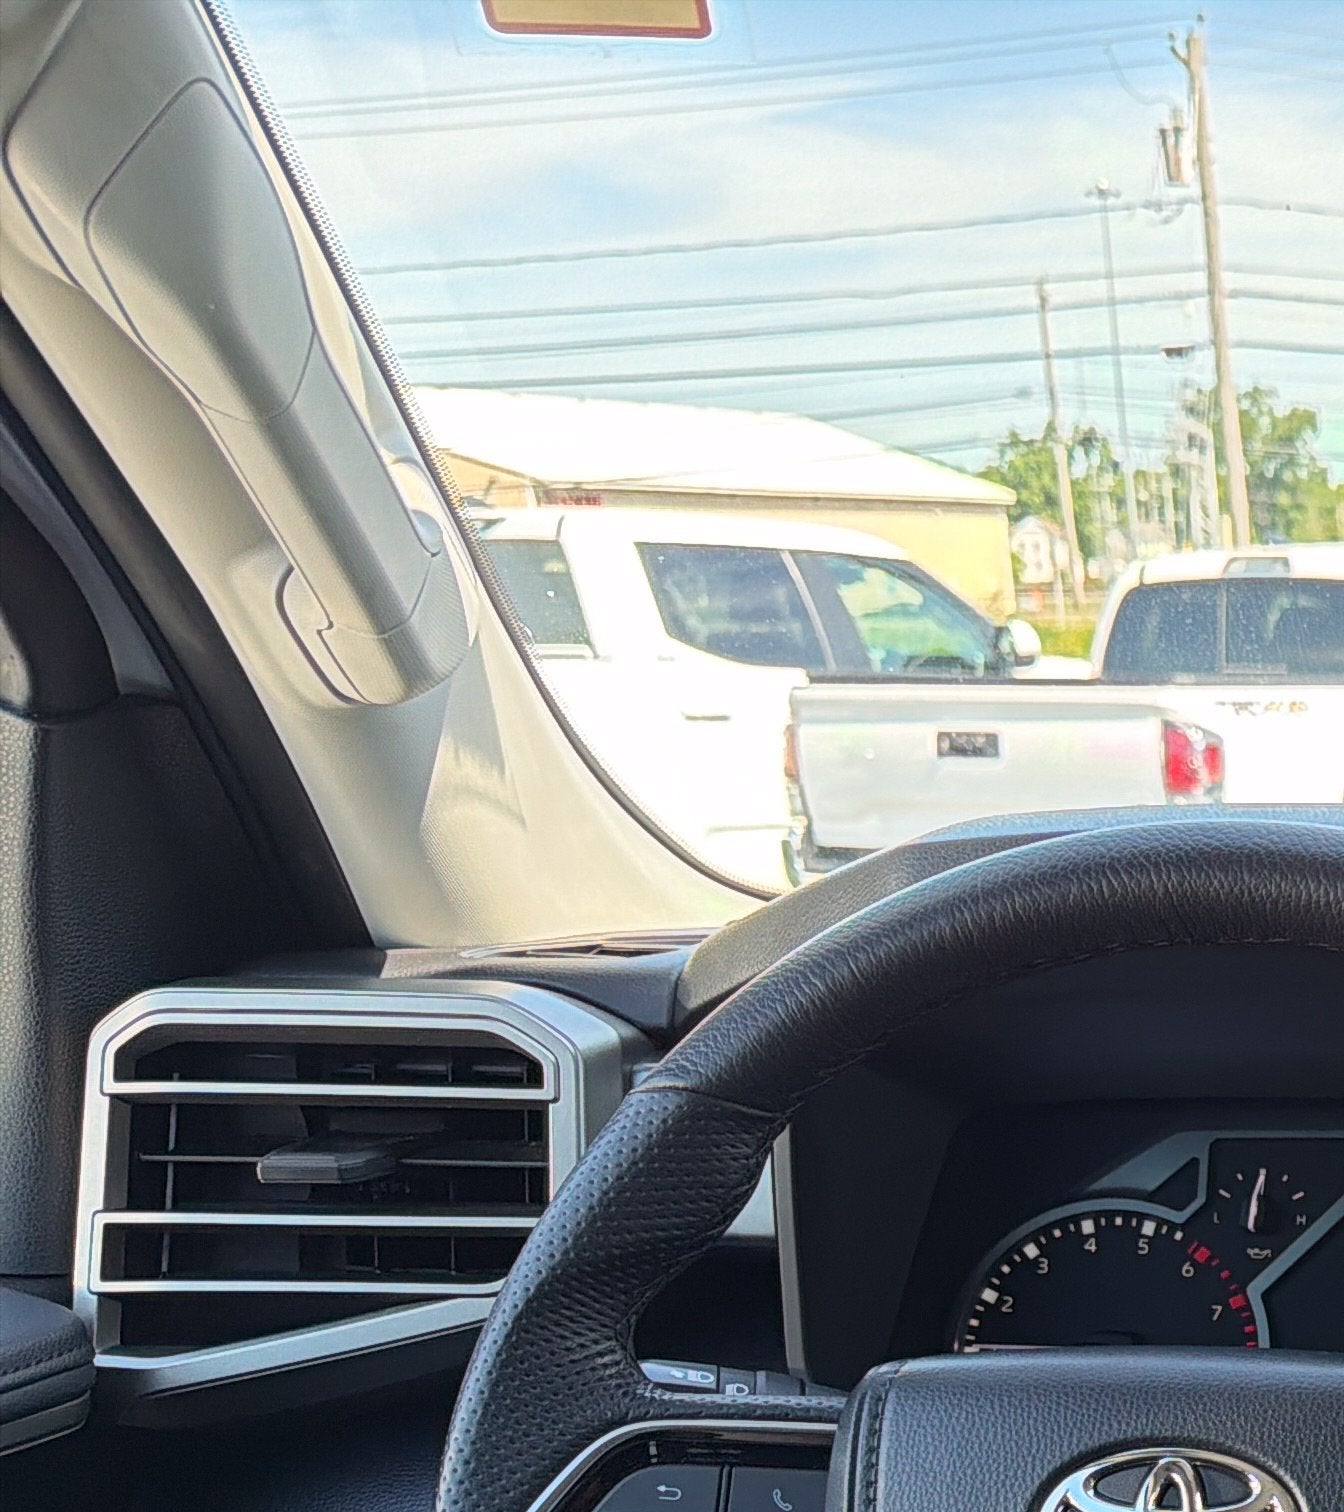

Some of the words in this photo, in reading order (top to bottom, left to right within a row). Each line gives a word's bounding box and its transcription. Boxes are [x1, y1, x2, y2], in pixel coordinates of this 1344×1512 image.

[1083, 1239, 1097, 1253] 4
[1138, 1240, 1149, 1254] 5
[1038, 1260, 1049, 1274] 3
[1182, 1263, 1194, 1278] 6
[1001, 1298, 1013, 1313] 2
[1211, 1306, 1223, 1321] 7
